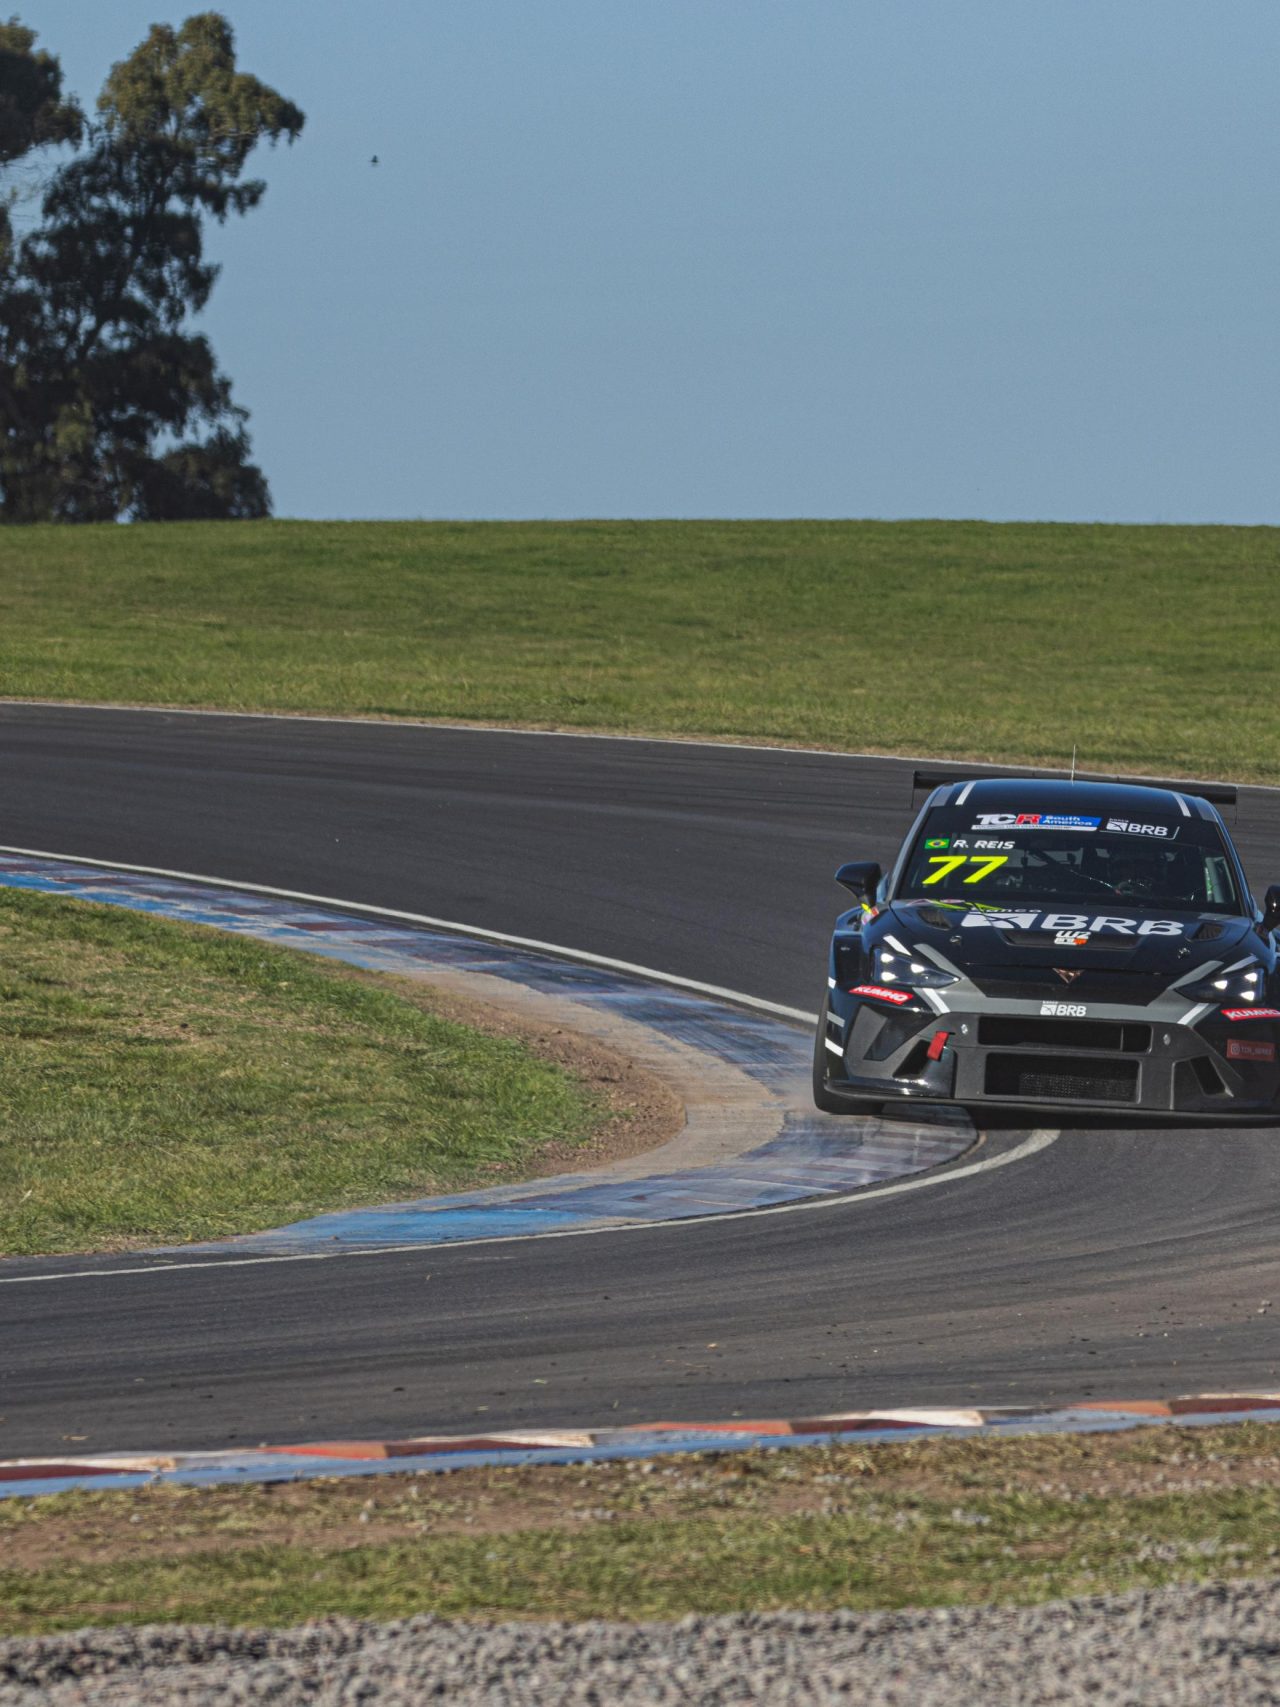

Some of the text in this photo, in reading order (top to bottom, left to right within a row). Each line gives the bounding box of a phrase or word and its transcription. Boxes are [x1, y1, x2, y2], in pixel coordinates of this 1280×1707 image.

[976, 813, 1041, 825] TCR
[1127, 823, 1168, 836] BRB
[952, 839, 1016, 849] R. REIS
[922, 855, 1009, 884] 77
[1040, 914, 1185, 936] BRB
[854, 986, 910, 1002] KUMHO
[1056, 1004, 1087, 1017] BRB
